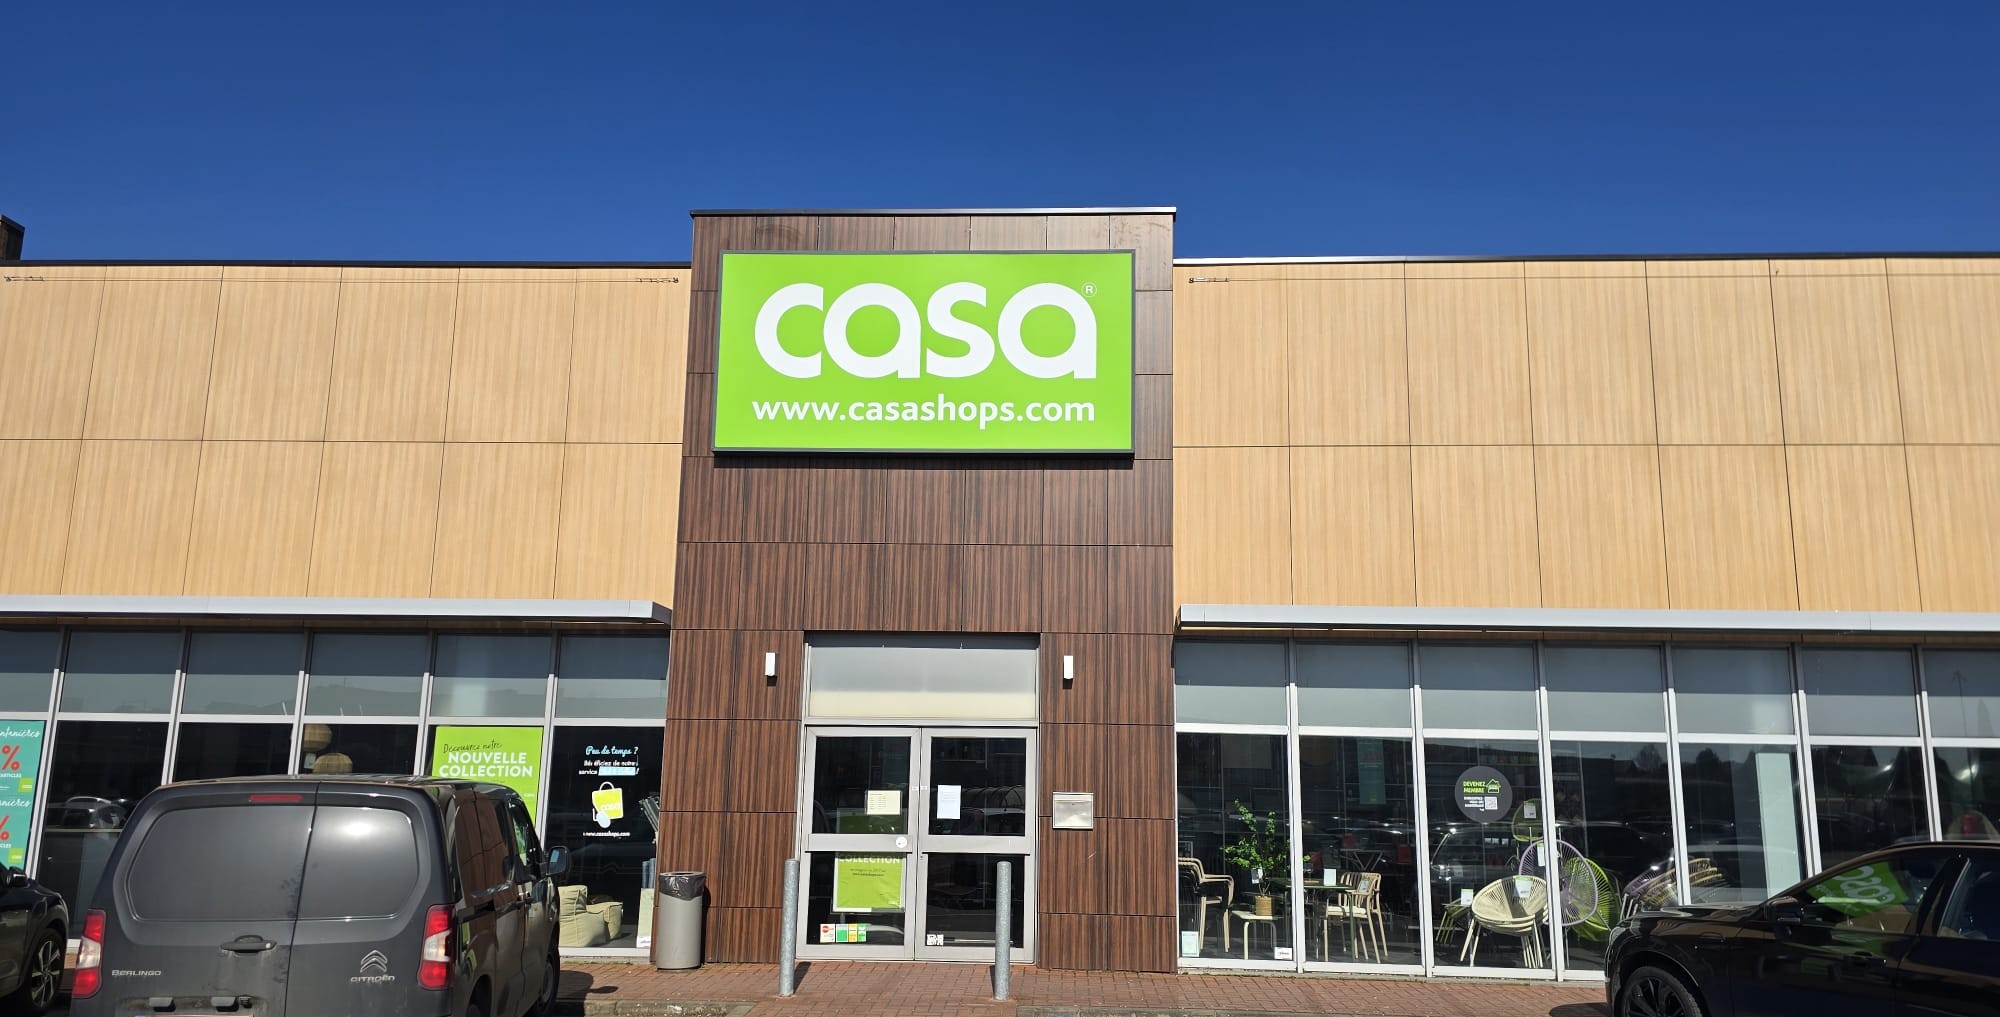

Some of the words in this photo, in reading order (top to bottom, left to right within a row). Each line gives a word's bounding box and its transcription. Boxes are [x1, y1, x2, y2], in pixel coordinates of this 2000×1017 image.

[754, 282, 1097, 379] casa
[752, 393, 1095, 430] www.casashops.com
[585, 745, 600, 756] Peu
[601, 745, 610, 755] de
[611, 746, 632, 757] temps
[448, 752, 527, 764] NOUVELLE
[438, 765, 533, 777] COLLECTION
